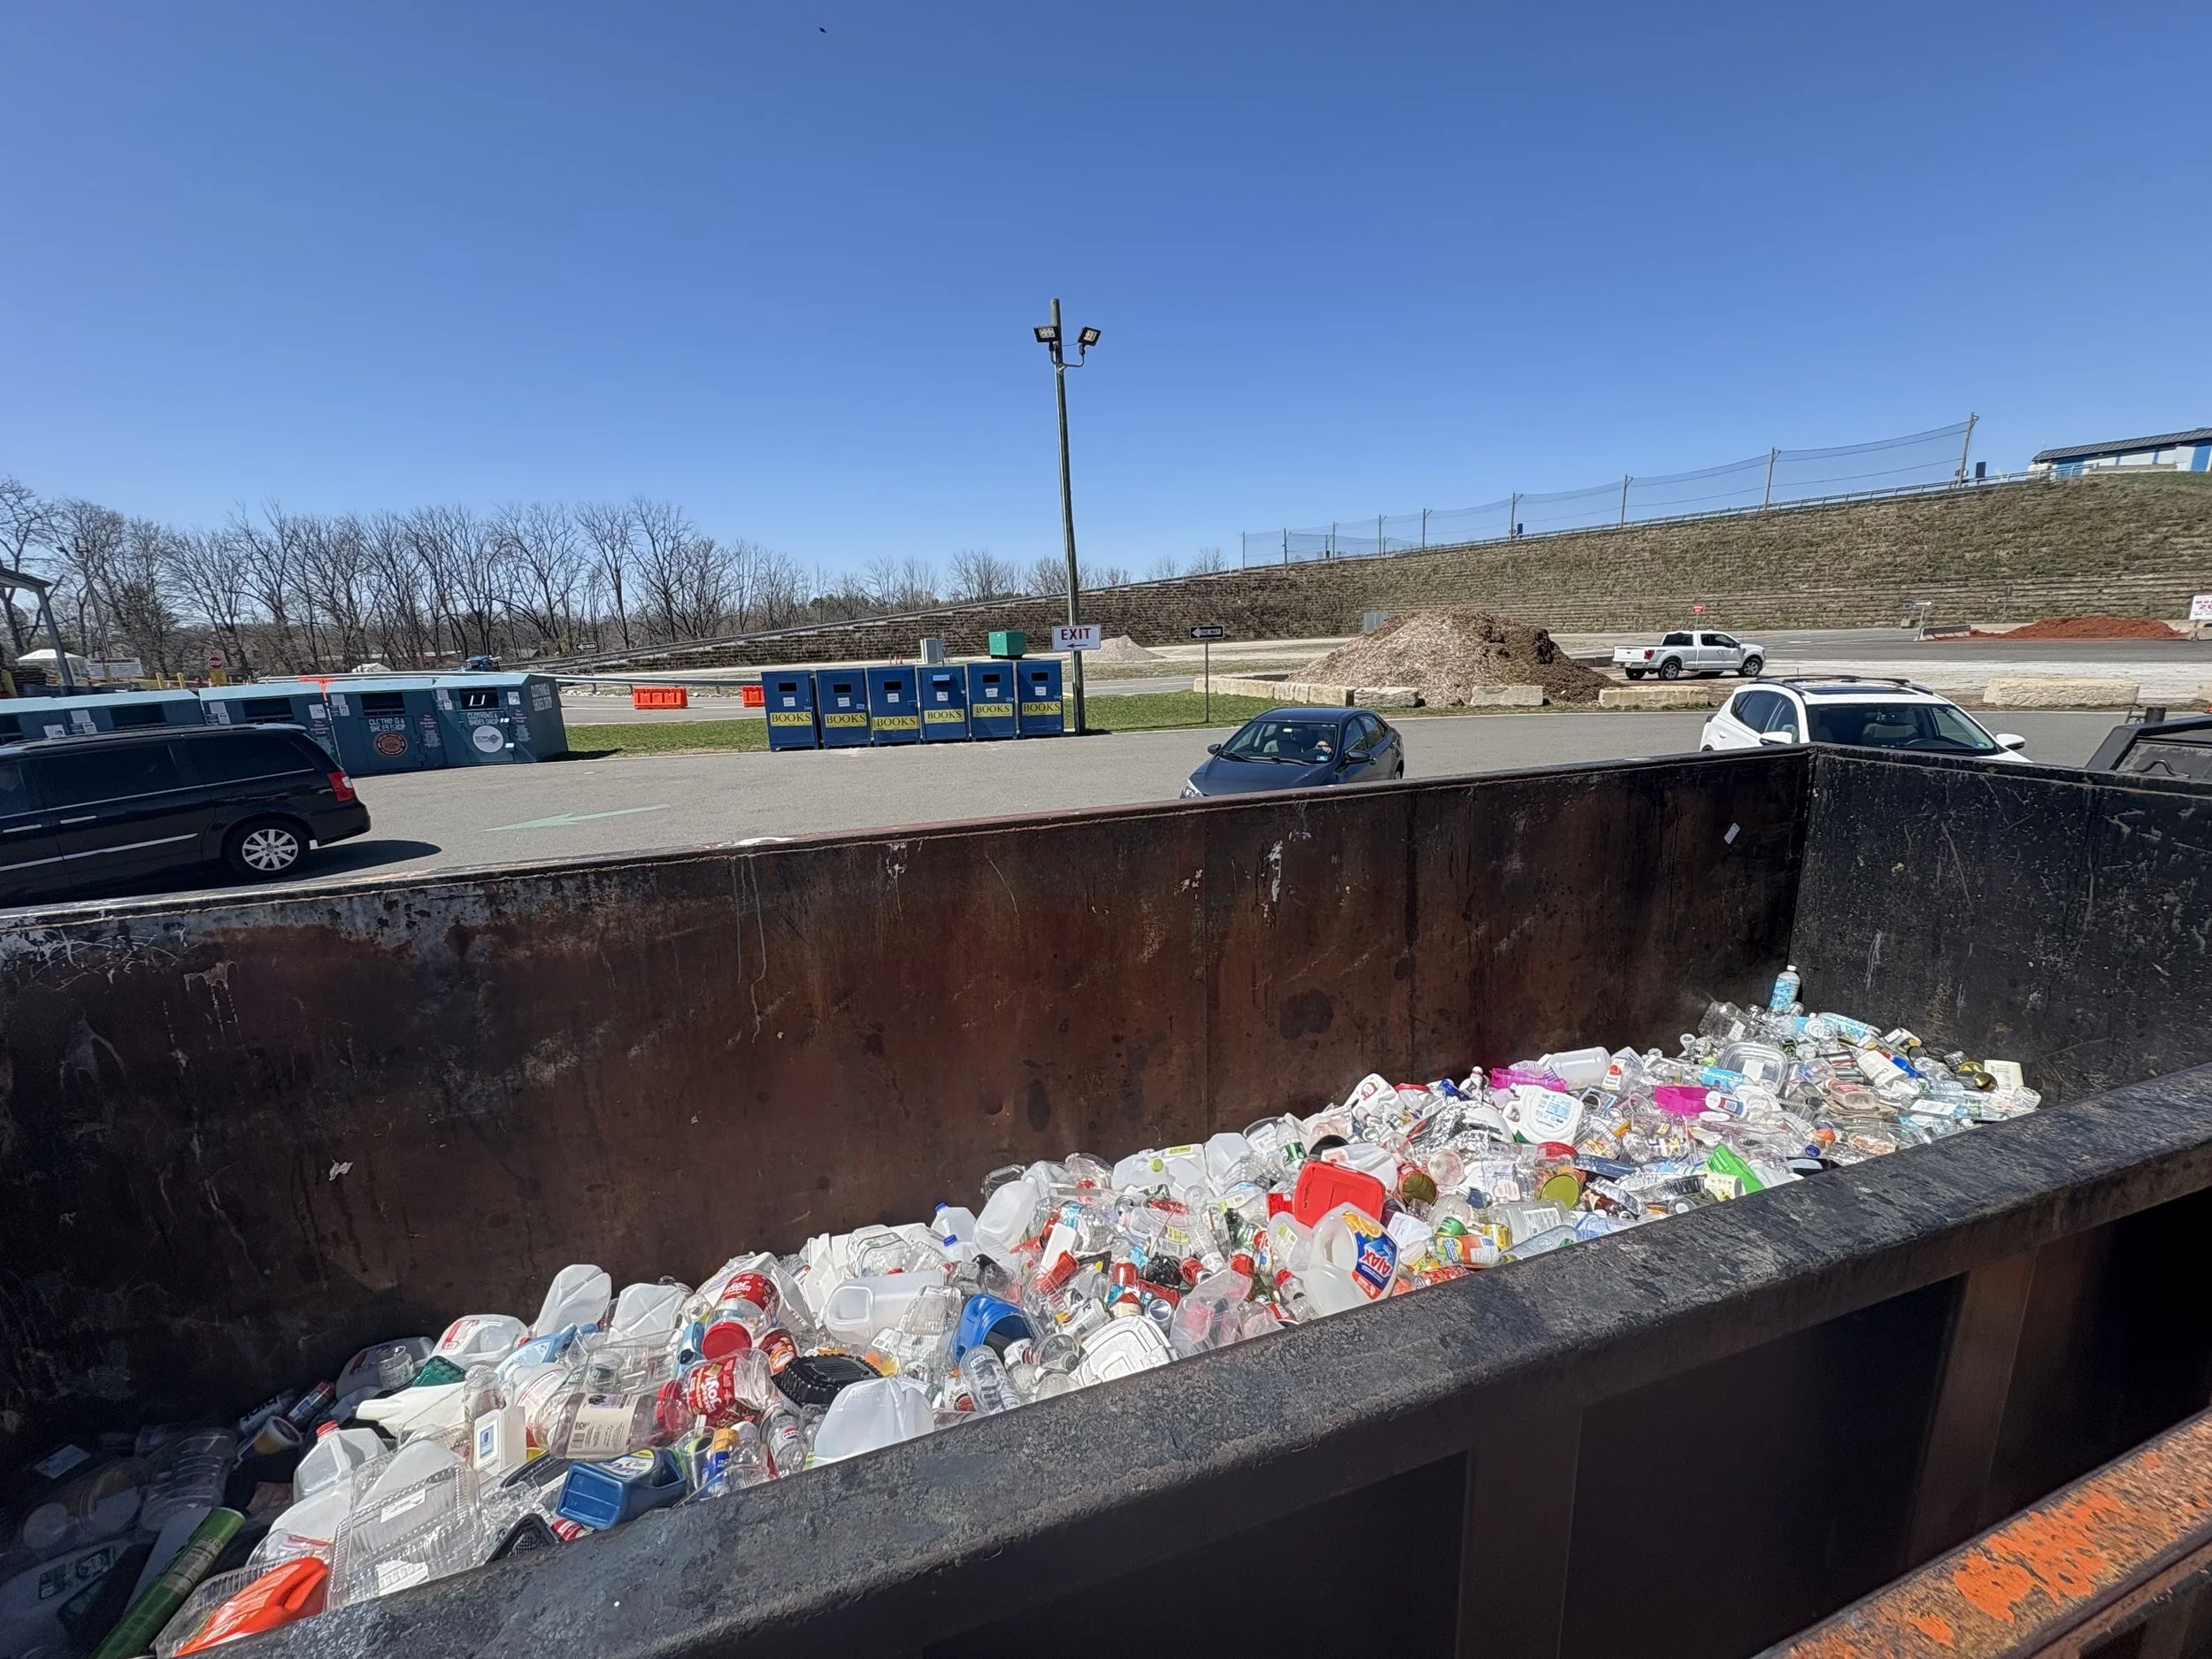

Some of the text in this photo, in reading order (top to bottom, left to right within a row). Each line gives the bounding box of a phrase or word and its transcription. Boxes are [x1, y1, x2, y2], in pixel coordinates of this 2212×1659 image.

[1060, 627, 1092, 641] EXIT
[976, 704, 1010, 714] BOOKS
[1023, 703, 1061, 712] BOOKS
[772, 713, 811, 723] BOOKS
[826, 713, 866, 725] BOOKS
[927, 710, 962, 720] BOOKS
[877, 717, 916, 727] BOOKS
[1359, 1248, 1394, 1276] AJAX
